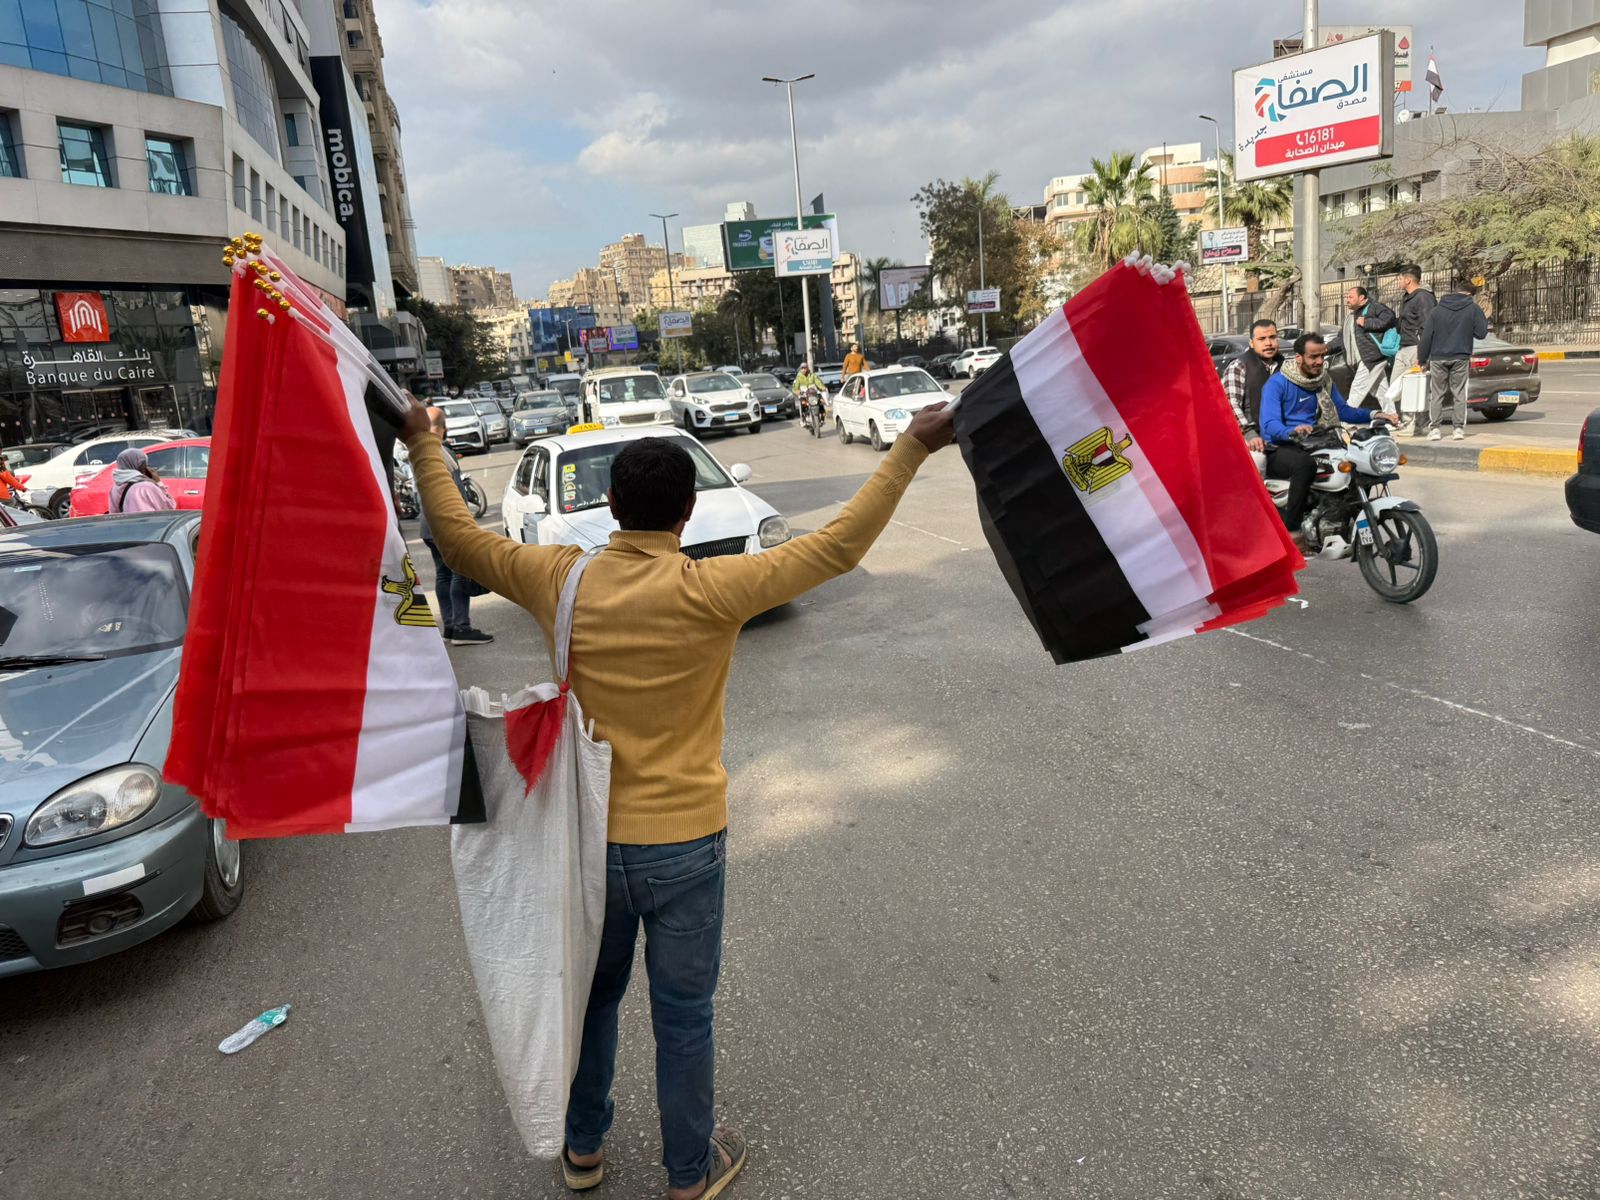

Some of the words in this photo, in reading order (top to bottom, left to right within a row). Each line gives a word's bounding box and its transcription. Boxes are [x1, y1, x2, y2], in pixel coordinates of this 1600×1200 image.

[1277, 68, 1313, 84] مستشفى
[1277, 63, 1368, 110] الصفا
[1336, 96, 1367, 110] مصدق
[1304, 127, 1334, 145] 16181
[1285, 144, 1319, 159] الصحابة
[1320, 140, 1345, 154] ميدان
[22, 349, 104, 370] القاهرة
[26, 370, 88, 386] Banque
[93, 367, 113, 381] du
[117, 366, 156, 380] Caire
